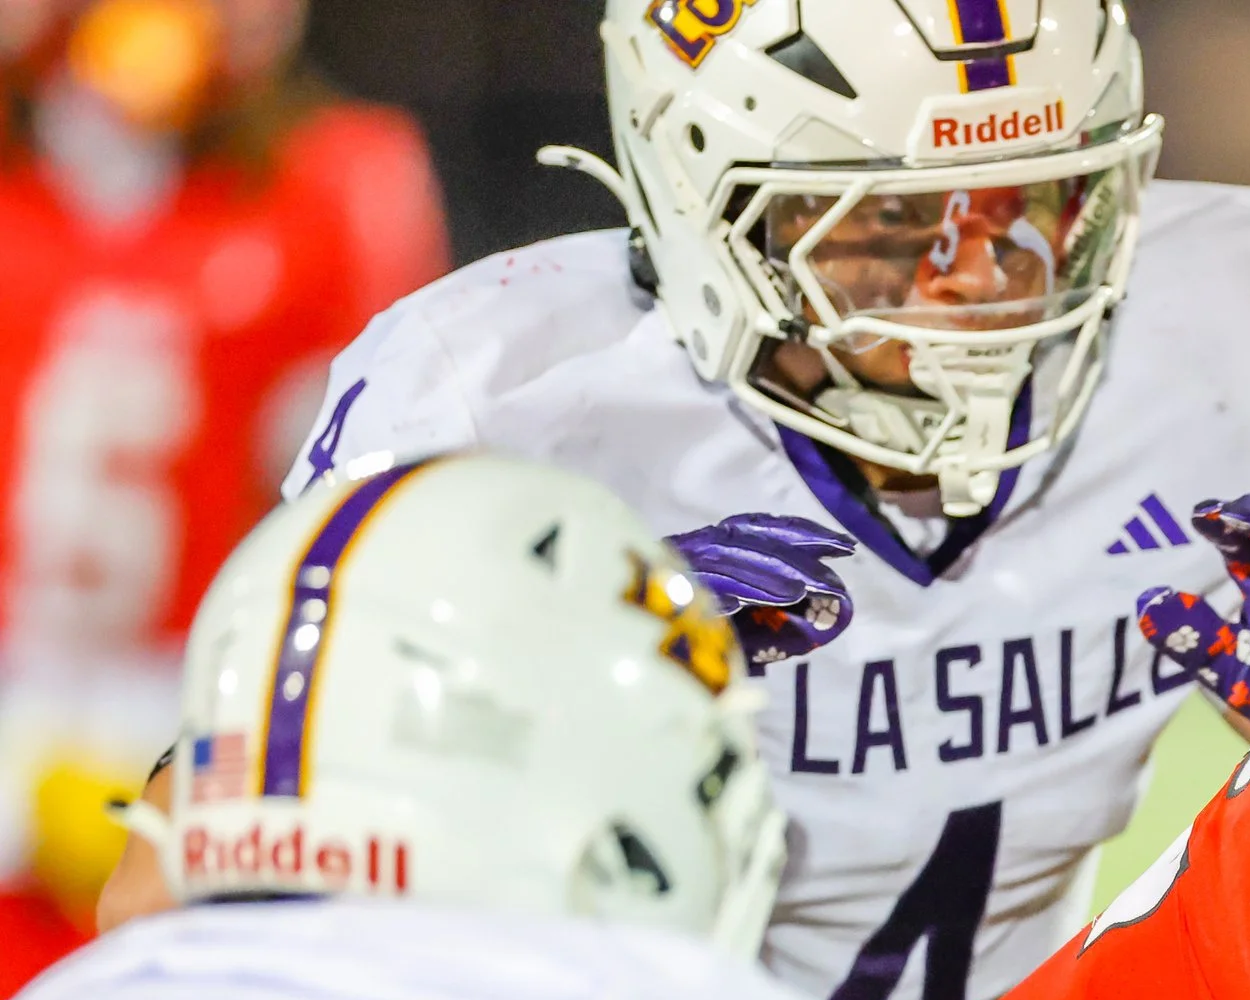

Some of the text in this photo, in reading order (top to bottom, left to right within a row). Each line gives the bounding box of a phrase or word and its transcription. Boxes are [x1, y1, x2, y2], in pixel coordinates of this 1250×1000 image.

[933, 99, 1064, 148] Riddell
[791, 658, 908, 775] LA
[184, 824, 409, 892] Riddell
